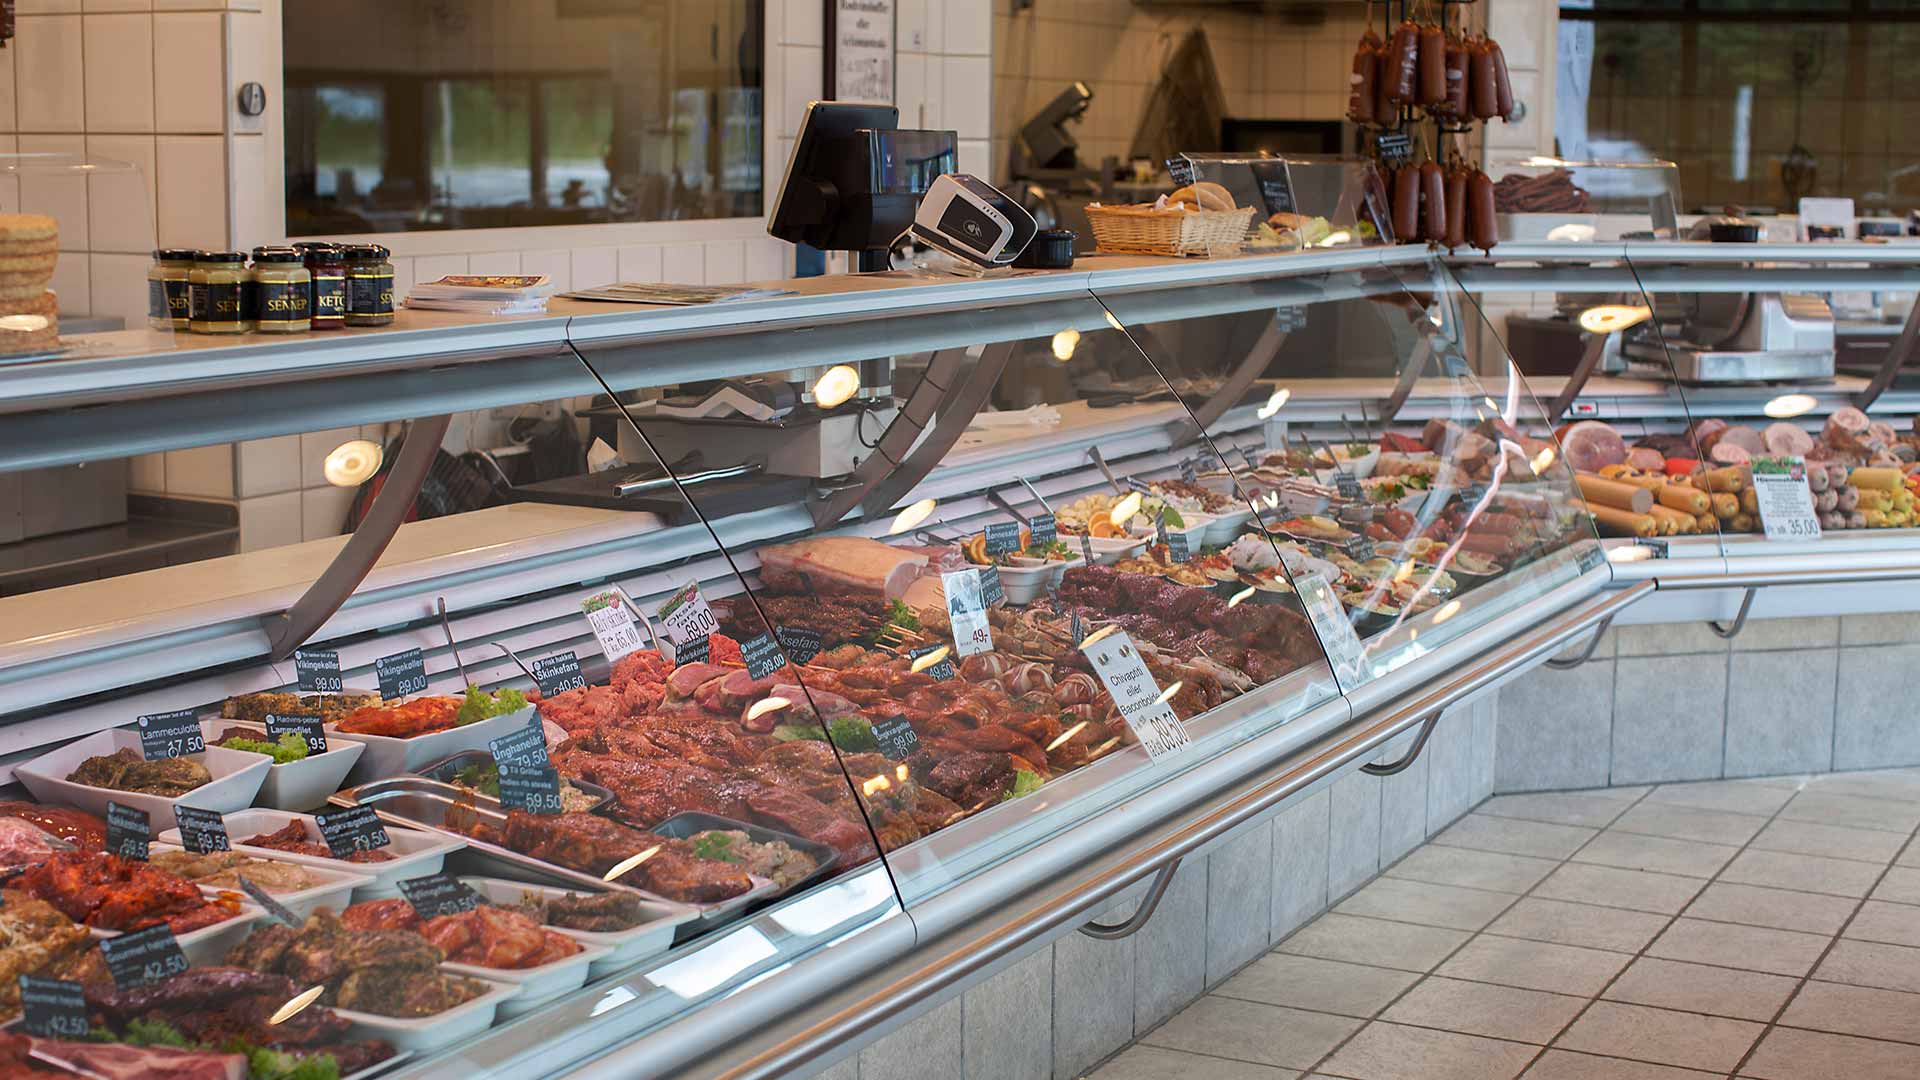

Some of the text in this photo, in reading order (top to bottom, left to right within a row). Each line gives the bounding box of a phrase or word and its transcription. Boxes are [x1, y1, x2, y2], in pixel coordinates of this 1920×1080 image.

[267, 299, 307, 311] SENNEP
[677, 610, 698, 628] fars
[685, 608, 715, 640] 69,00
[536, 662, 579, 681] Skinkefars
[1126, 684, 1142, 697] eller
[141, 723, 201, 740] Lammeculotte
[492, 734, 542, 761] Unghanelår
